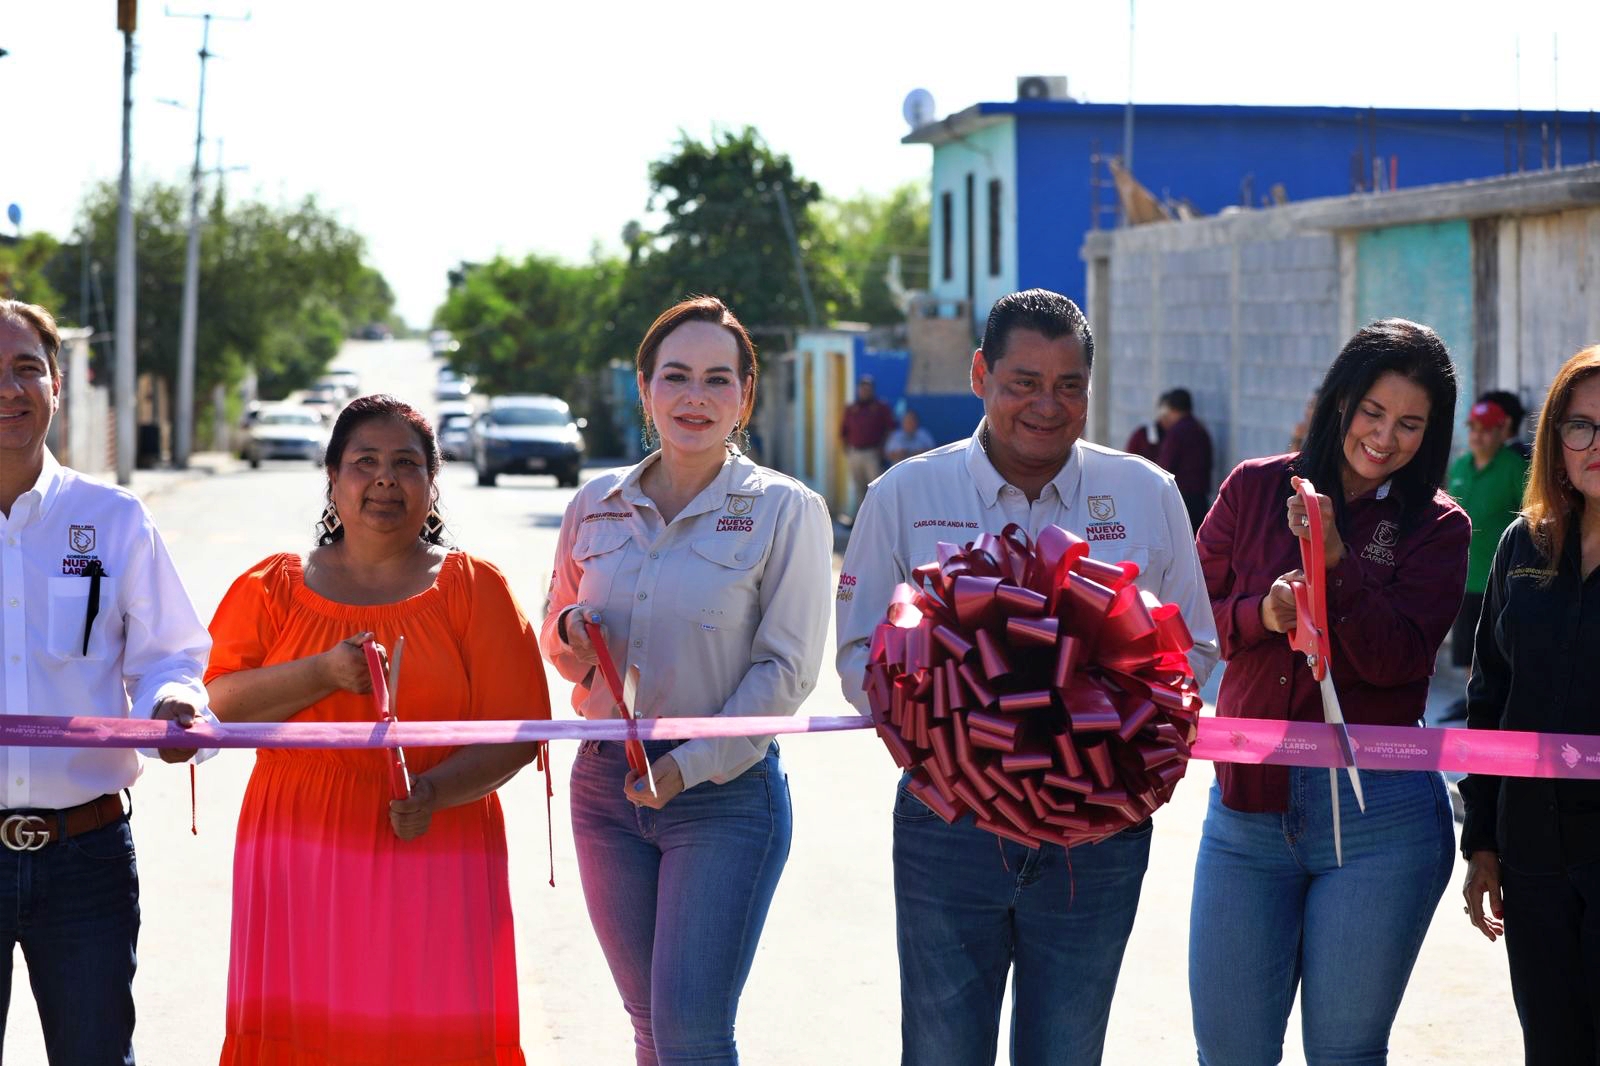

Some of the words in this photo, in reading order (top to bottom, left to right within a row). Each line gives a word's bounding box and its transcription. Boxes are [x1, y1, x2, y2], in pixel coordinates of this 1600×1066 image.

[718, 518, 754, 526] NUEVO
[913, 520, 937, 528] CARLOS
[1086, 525, 1125, 534] NUEVO
[1087, 532, 1127, 541] LAREDO
[1284, 742, 1318, 751] LAREDO
[1395, 748, 1428, 756] LAREDO
